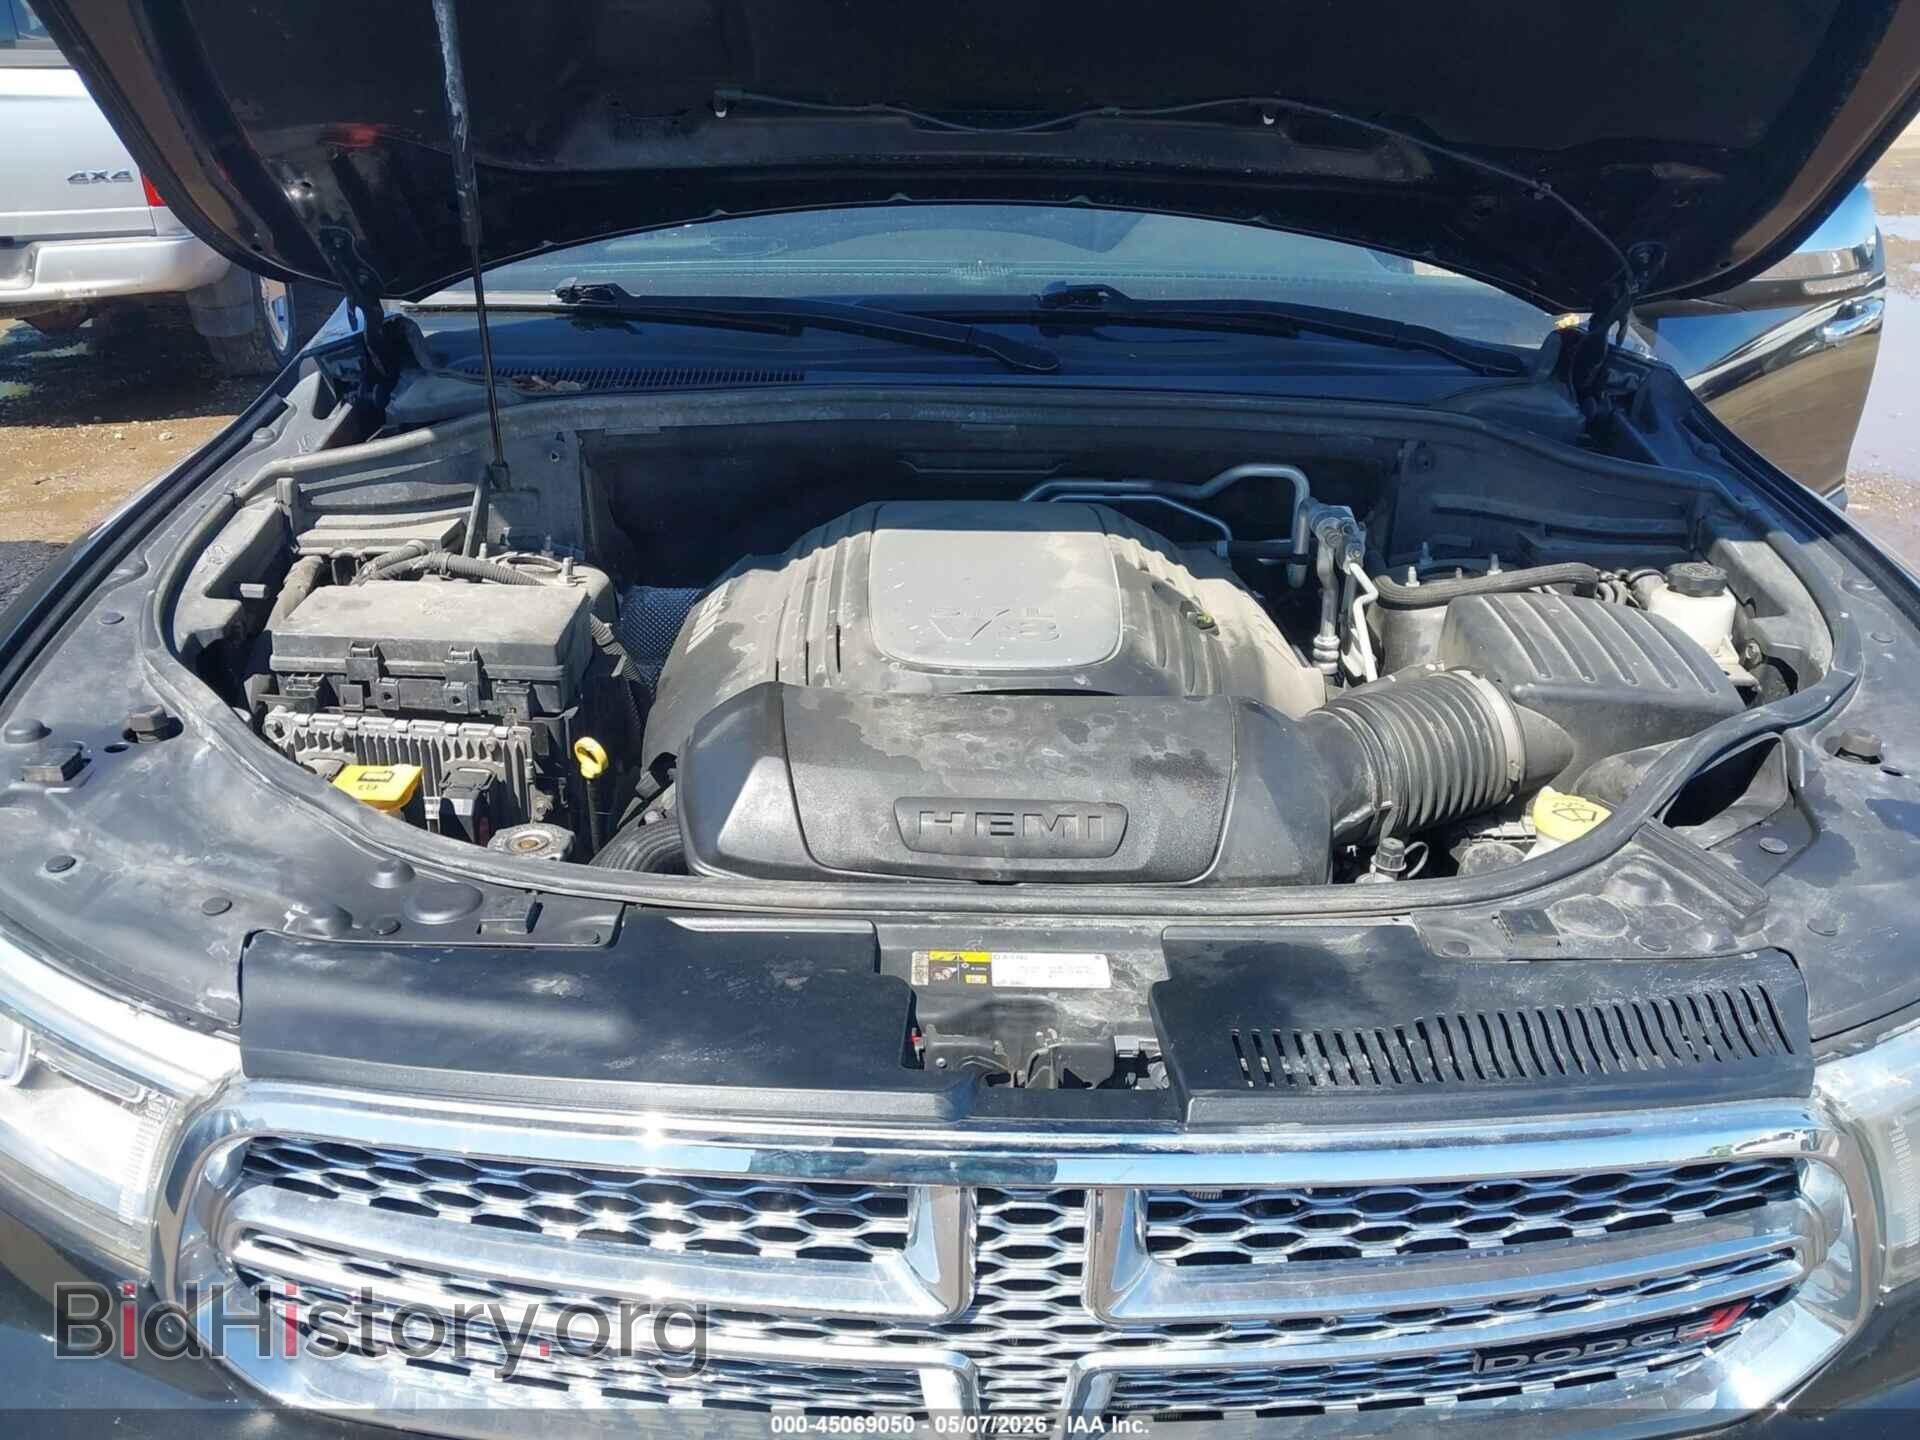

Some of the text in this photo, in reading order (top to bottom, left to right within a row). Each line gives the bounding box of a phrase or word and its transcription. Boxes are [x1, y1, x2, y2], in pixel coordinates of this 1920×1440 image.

[929, 607, 1061, 642] V8
[918, 811, 1104, 842] HEMI
[1484, 1321, 1708, 1374] DODGE
